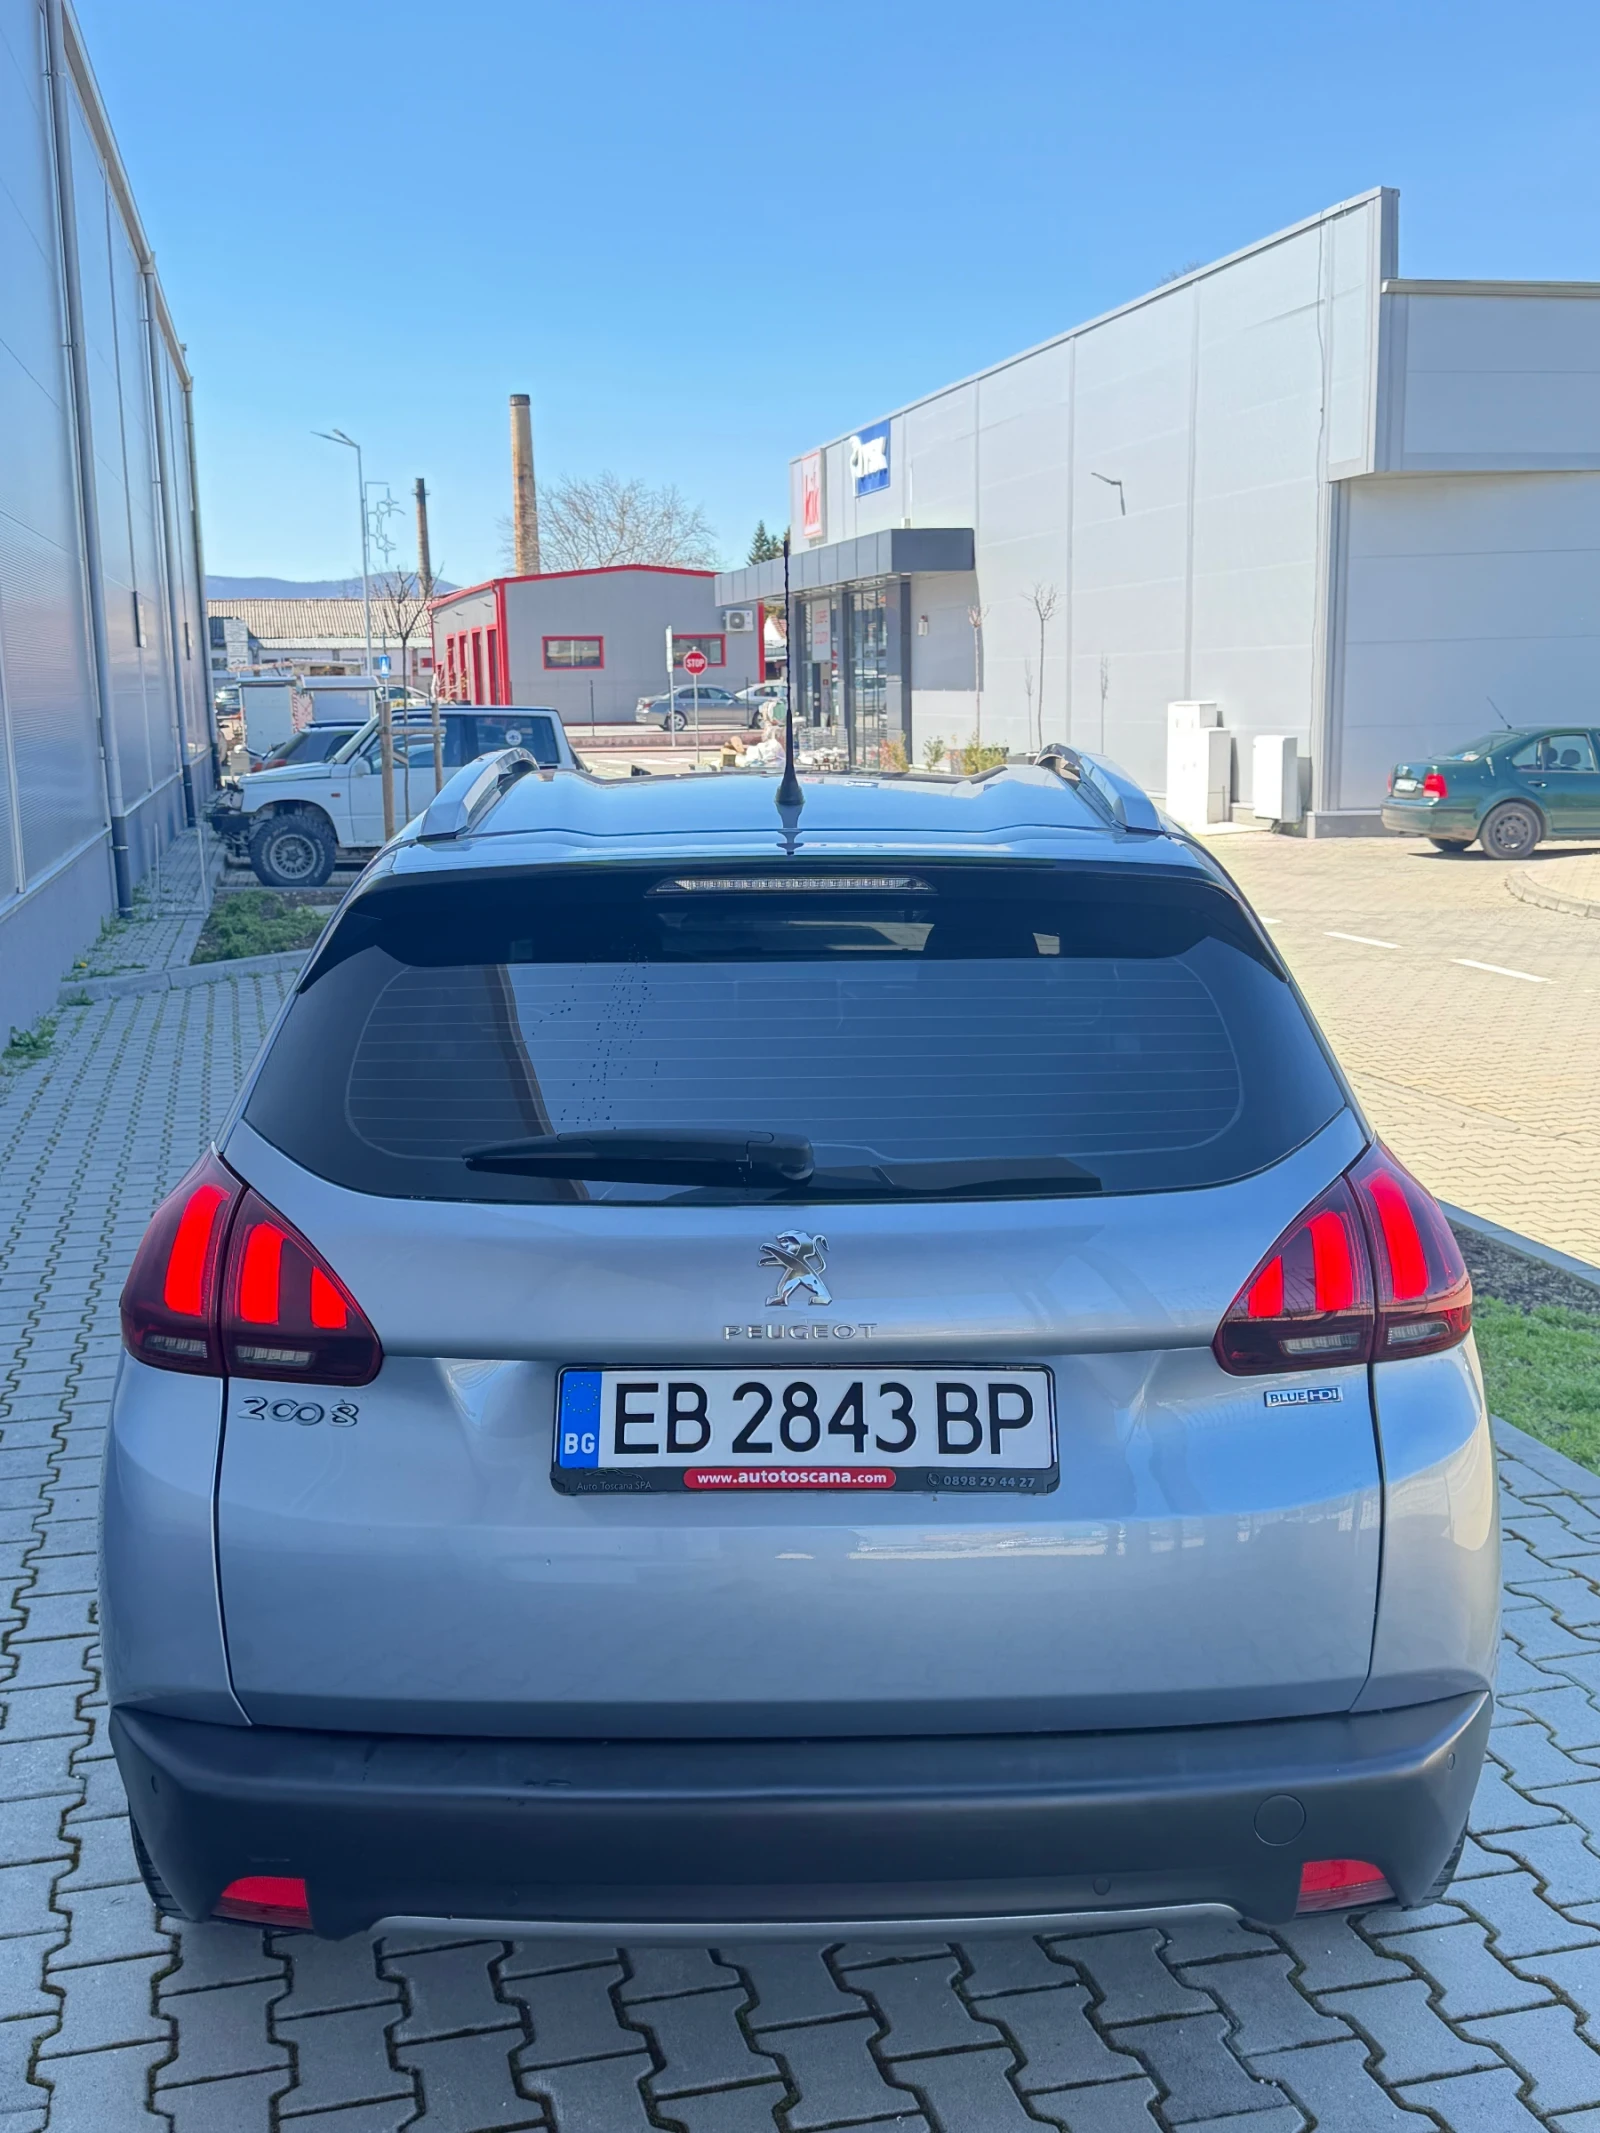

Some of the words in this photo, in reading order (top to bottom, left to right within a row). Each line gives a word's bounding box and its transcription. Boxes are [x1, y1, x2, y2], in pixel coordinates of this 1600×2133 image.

[686, 658, 705, 668] STOP
[723, 1323, 878, 1341] PEUGEOT
[236, 1395, 360, 1428] 2008
[614, 1382, 711, 1454] EB
[731, 1381, 917, 1454] 2843
[935, 1383, 1034, 1454] BP
[564, 1432, 596, 1455] BG
[576, 1482, 598, 1491] Auto
[600, 1481, 633, 1491] Toscana
[635, 1481, 652, 1490] SPA
[696, 1470, 888, 1486] www.autotoscana.com
[943, 1475, 977, 1486] 0898
[979, 1476, 996, 1487] 29
[999, 1477, 1016, 1487] 44
[1019, 1477, 1036, 1488] 27
